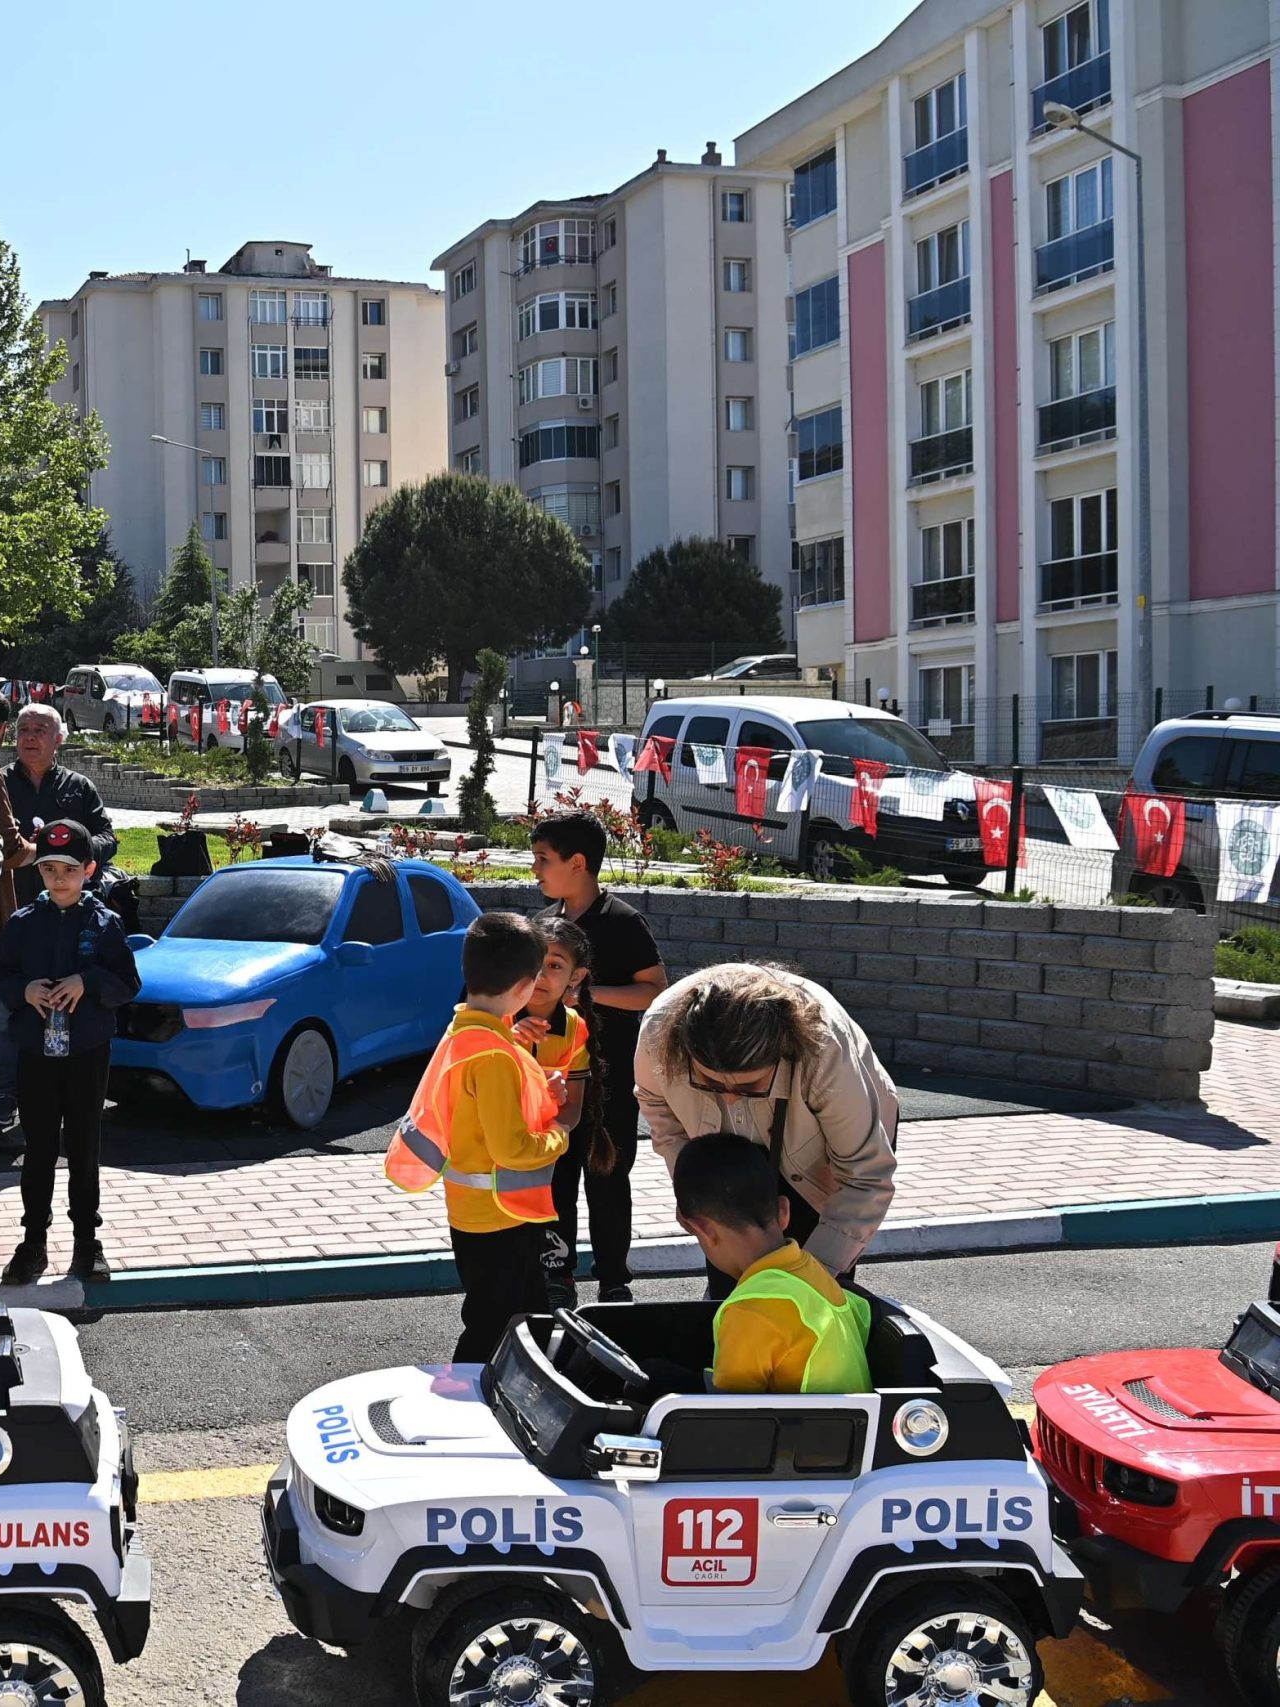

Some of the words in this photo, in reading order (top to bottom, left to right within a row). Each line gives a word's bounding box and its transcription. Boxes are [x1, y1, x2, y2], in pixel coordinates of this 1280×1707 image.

[312, 1404, 363, 1464] POLİS
[426, 1498, 584, 1543] POLİS
[677, 1508, 744, 1550] 112
[881, 1488, 1033, 1534] POLİS
[691, 1559, 727, 1572] ACİL
